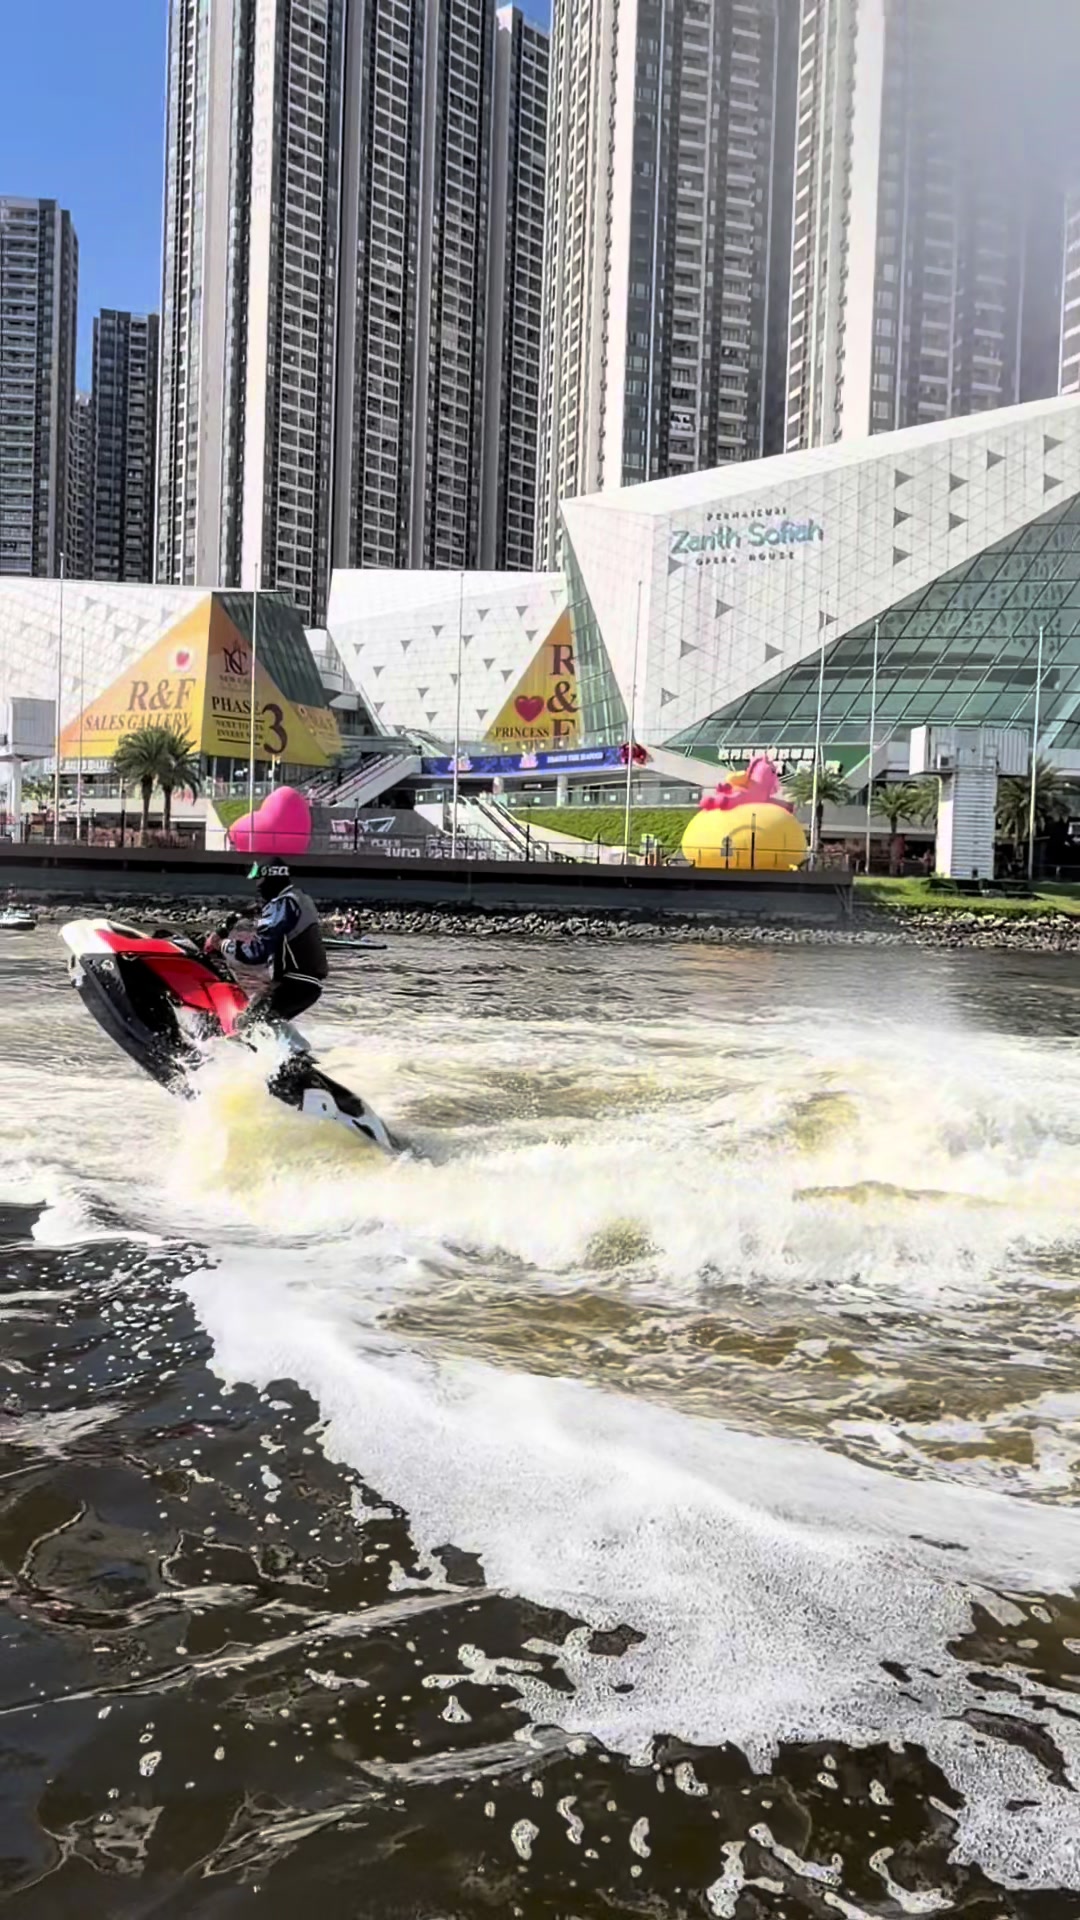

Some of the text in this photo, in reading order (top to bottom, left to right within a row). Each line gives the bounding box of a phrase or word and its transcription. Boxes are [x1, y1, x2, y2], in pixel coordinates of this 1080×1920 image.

[128, 678, 196, 711] R&F
[85, 713, 125, 730] SALES
[262, 703, 288, 754] 3
[495, 726, 549, 738] PRINCESS
